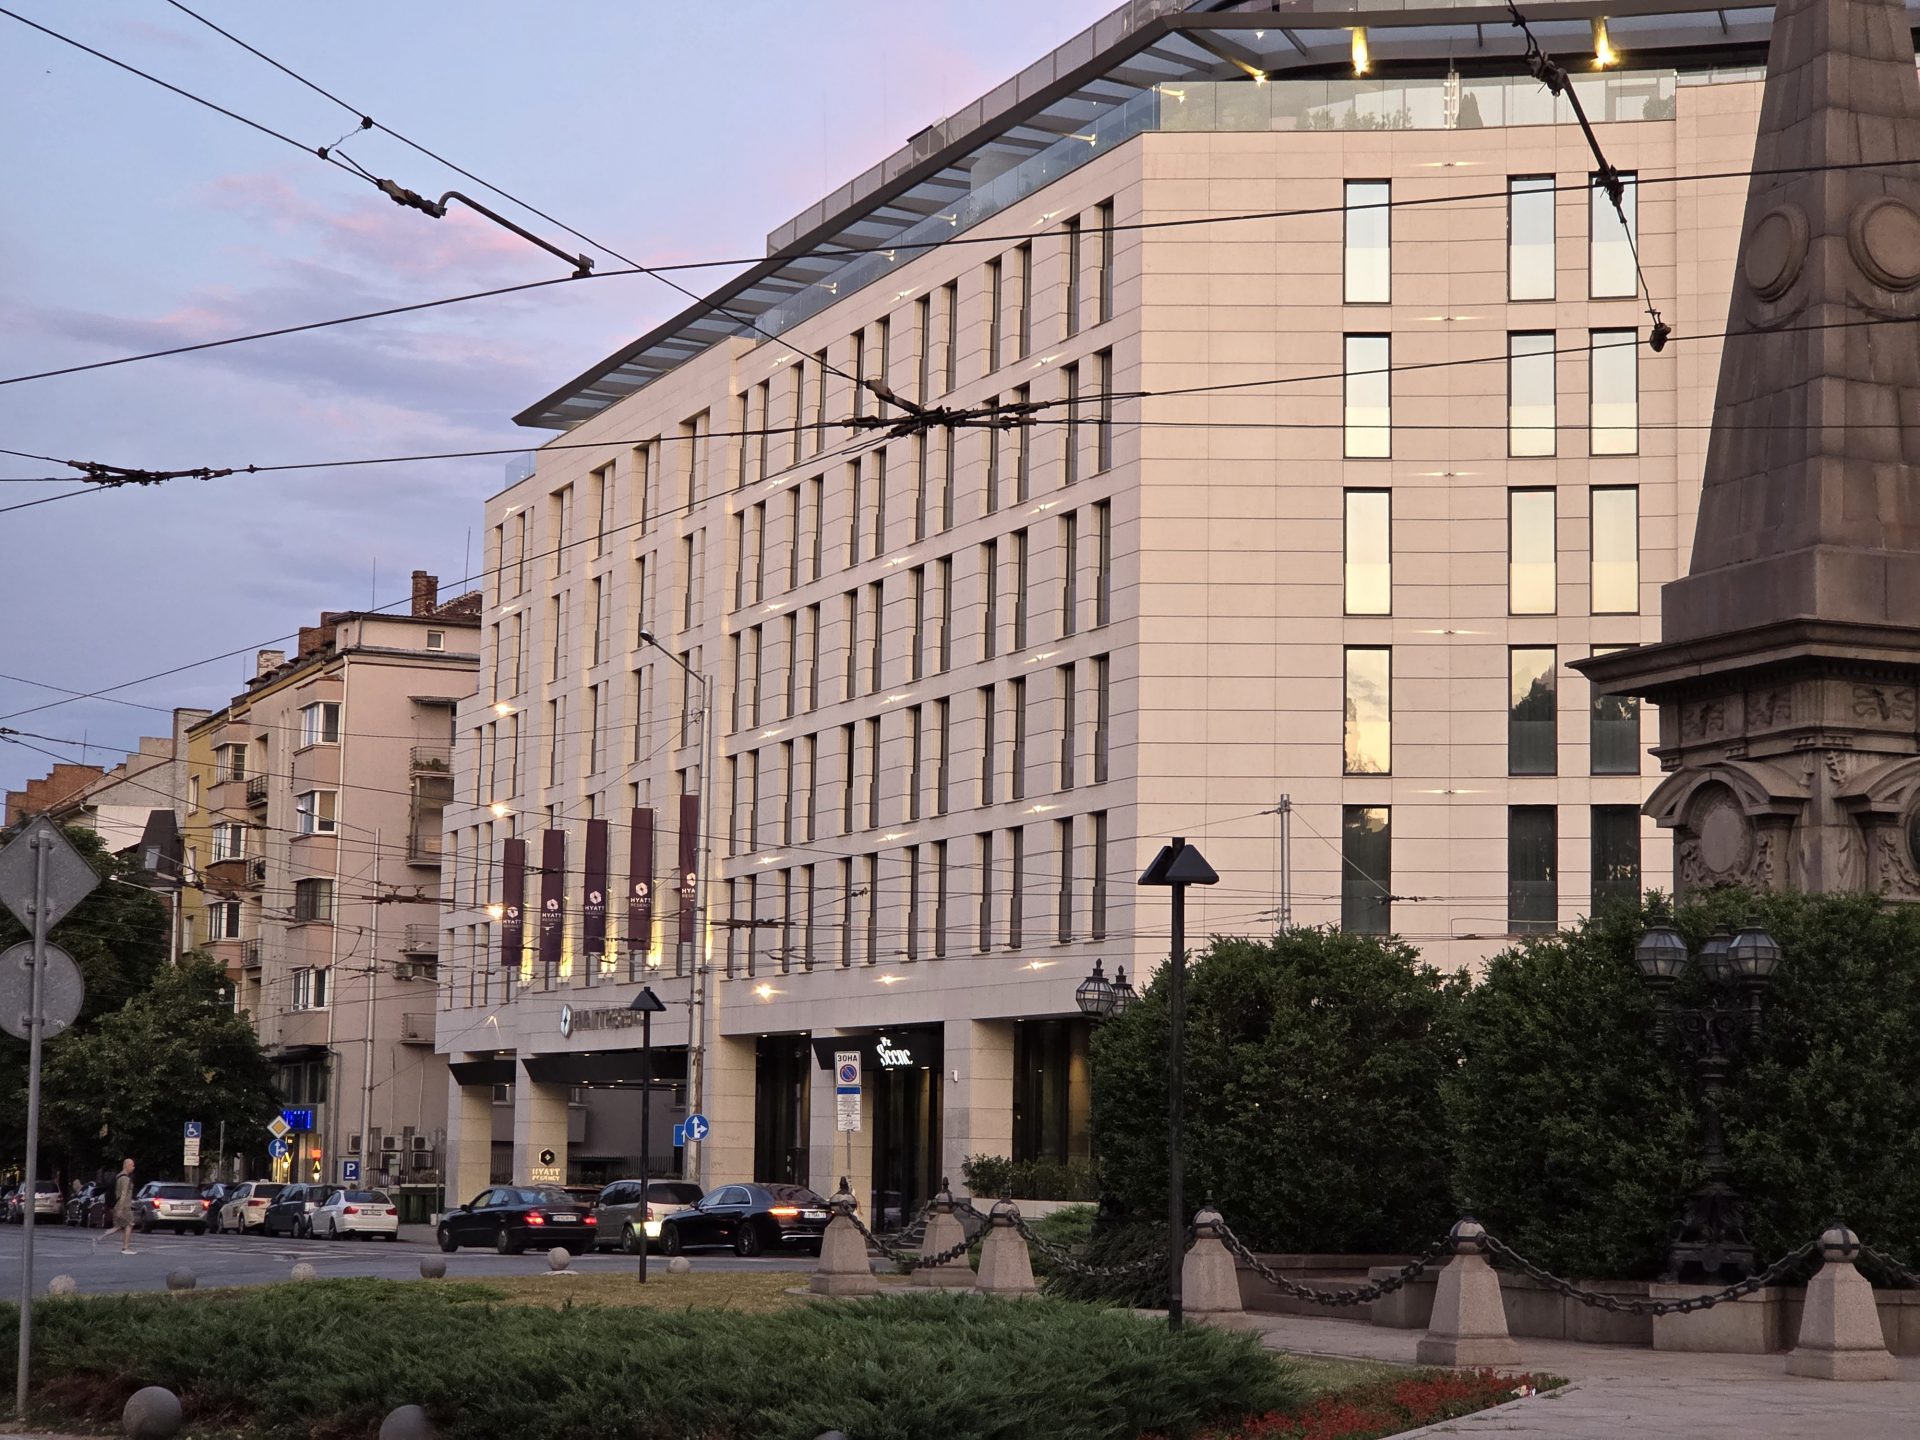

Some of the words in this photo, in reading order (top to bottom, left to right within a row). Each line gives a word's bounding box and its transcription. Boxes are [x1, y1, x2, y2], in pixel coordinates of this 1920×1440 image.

[837, 1054, 858, 1062] ЗОНА
[346, 1163, 356, 1176] P
[532, 1168, 560, 1176] HYATT
